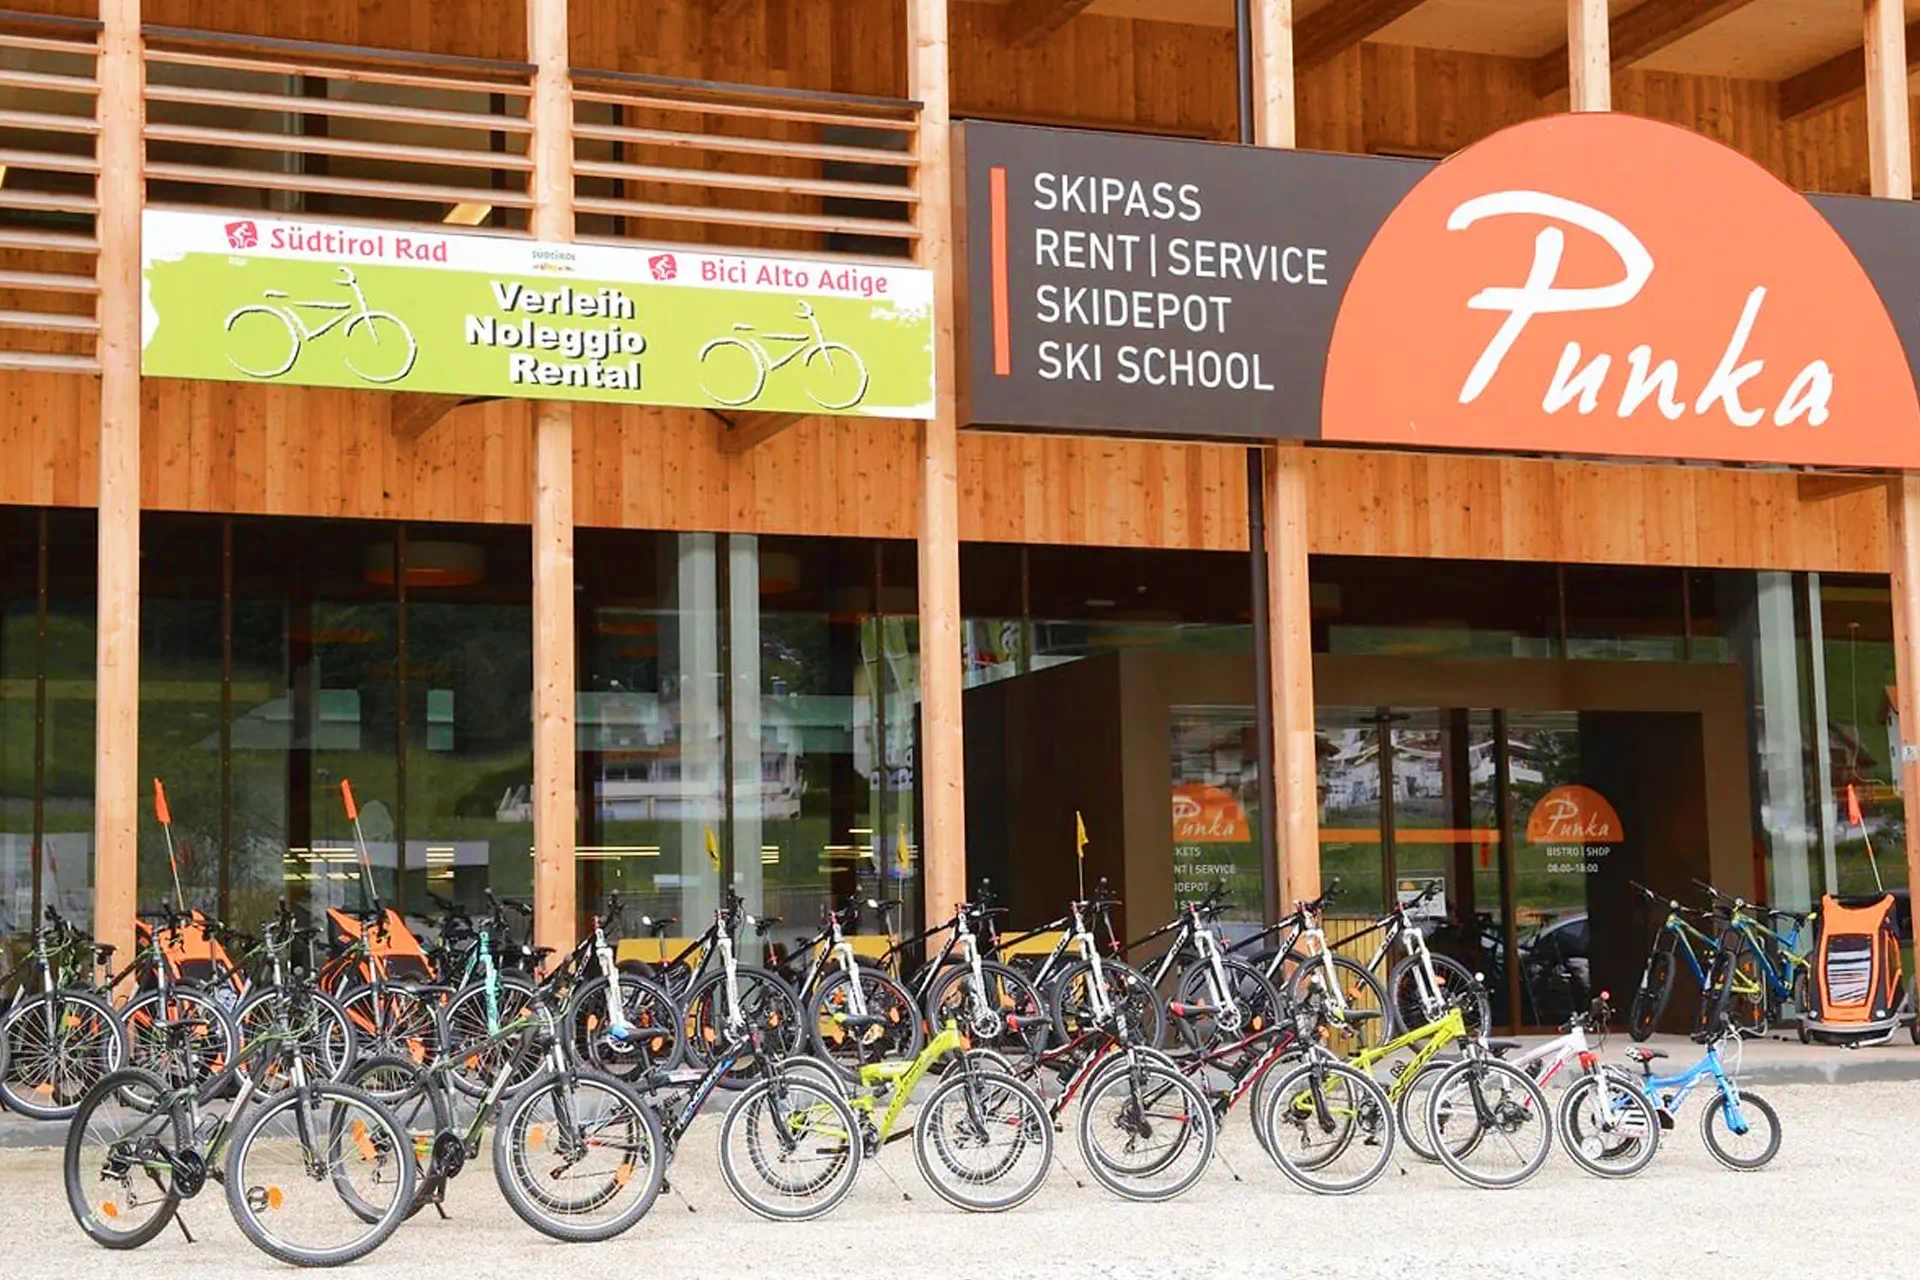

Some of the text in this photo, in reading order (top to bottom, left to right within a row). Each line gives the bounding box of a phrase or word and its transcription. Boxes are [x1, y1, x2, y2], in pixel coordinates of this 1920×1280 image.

[1033, 172, 1202, 221] SKIPASS
[270, 226, 448, 263] Südtirol Rad
[1034, 228, 1140, 272] RENT
[1168, 238, 1328, 285] SERVICE
[701, 259, 888, 297] Bici Alto Adige
[490, 280, 636, 319] Verleih
[1036, 284, 1232, 334] SKIDEPOT
[1446, 189, 1833, 428] Punka
[465, 315, 646, 360] Noleggio
[509, 353, 641, 390] Rental
[1037, 341, 1274, 391] SKI SCHOOL
[1544, 798, 1610, 838] Punka
[1175, 846, 1201, 858] KETS
[1195, 863, 1236, 875] SERVICE
[1586, 846, 1611, 857] SHOP
[1174, 882, 1209, 893] IDEPOT
